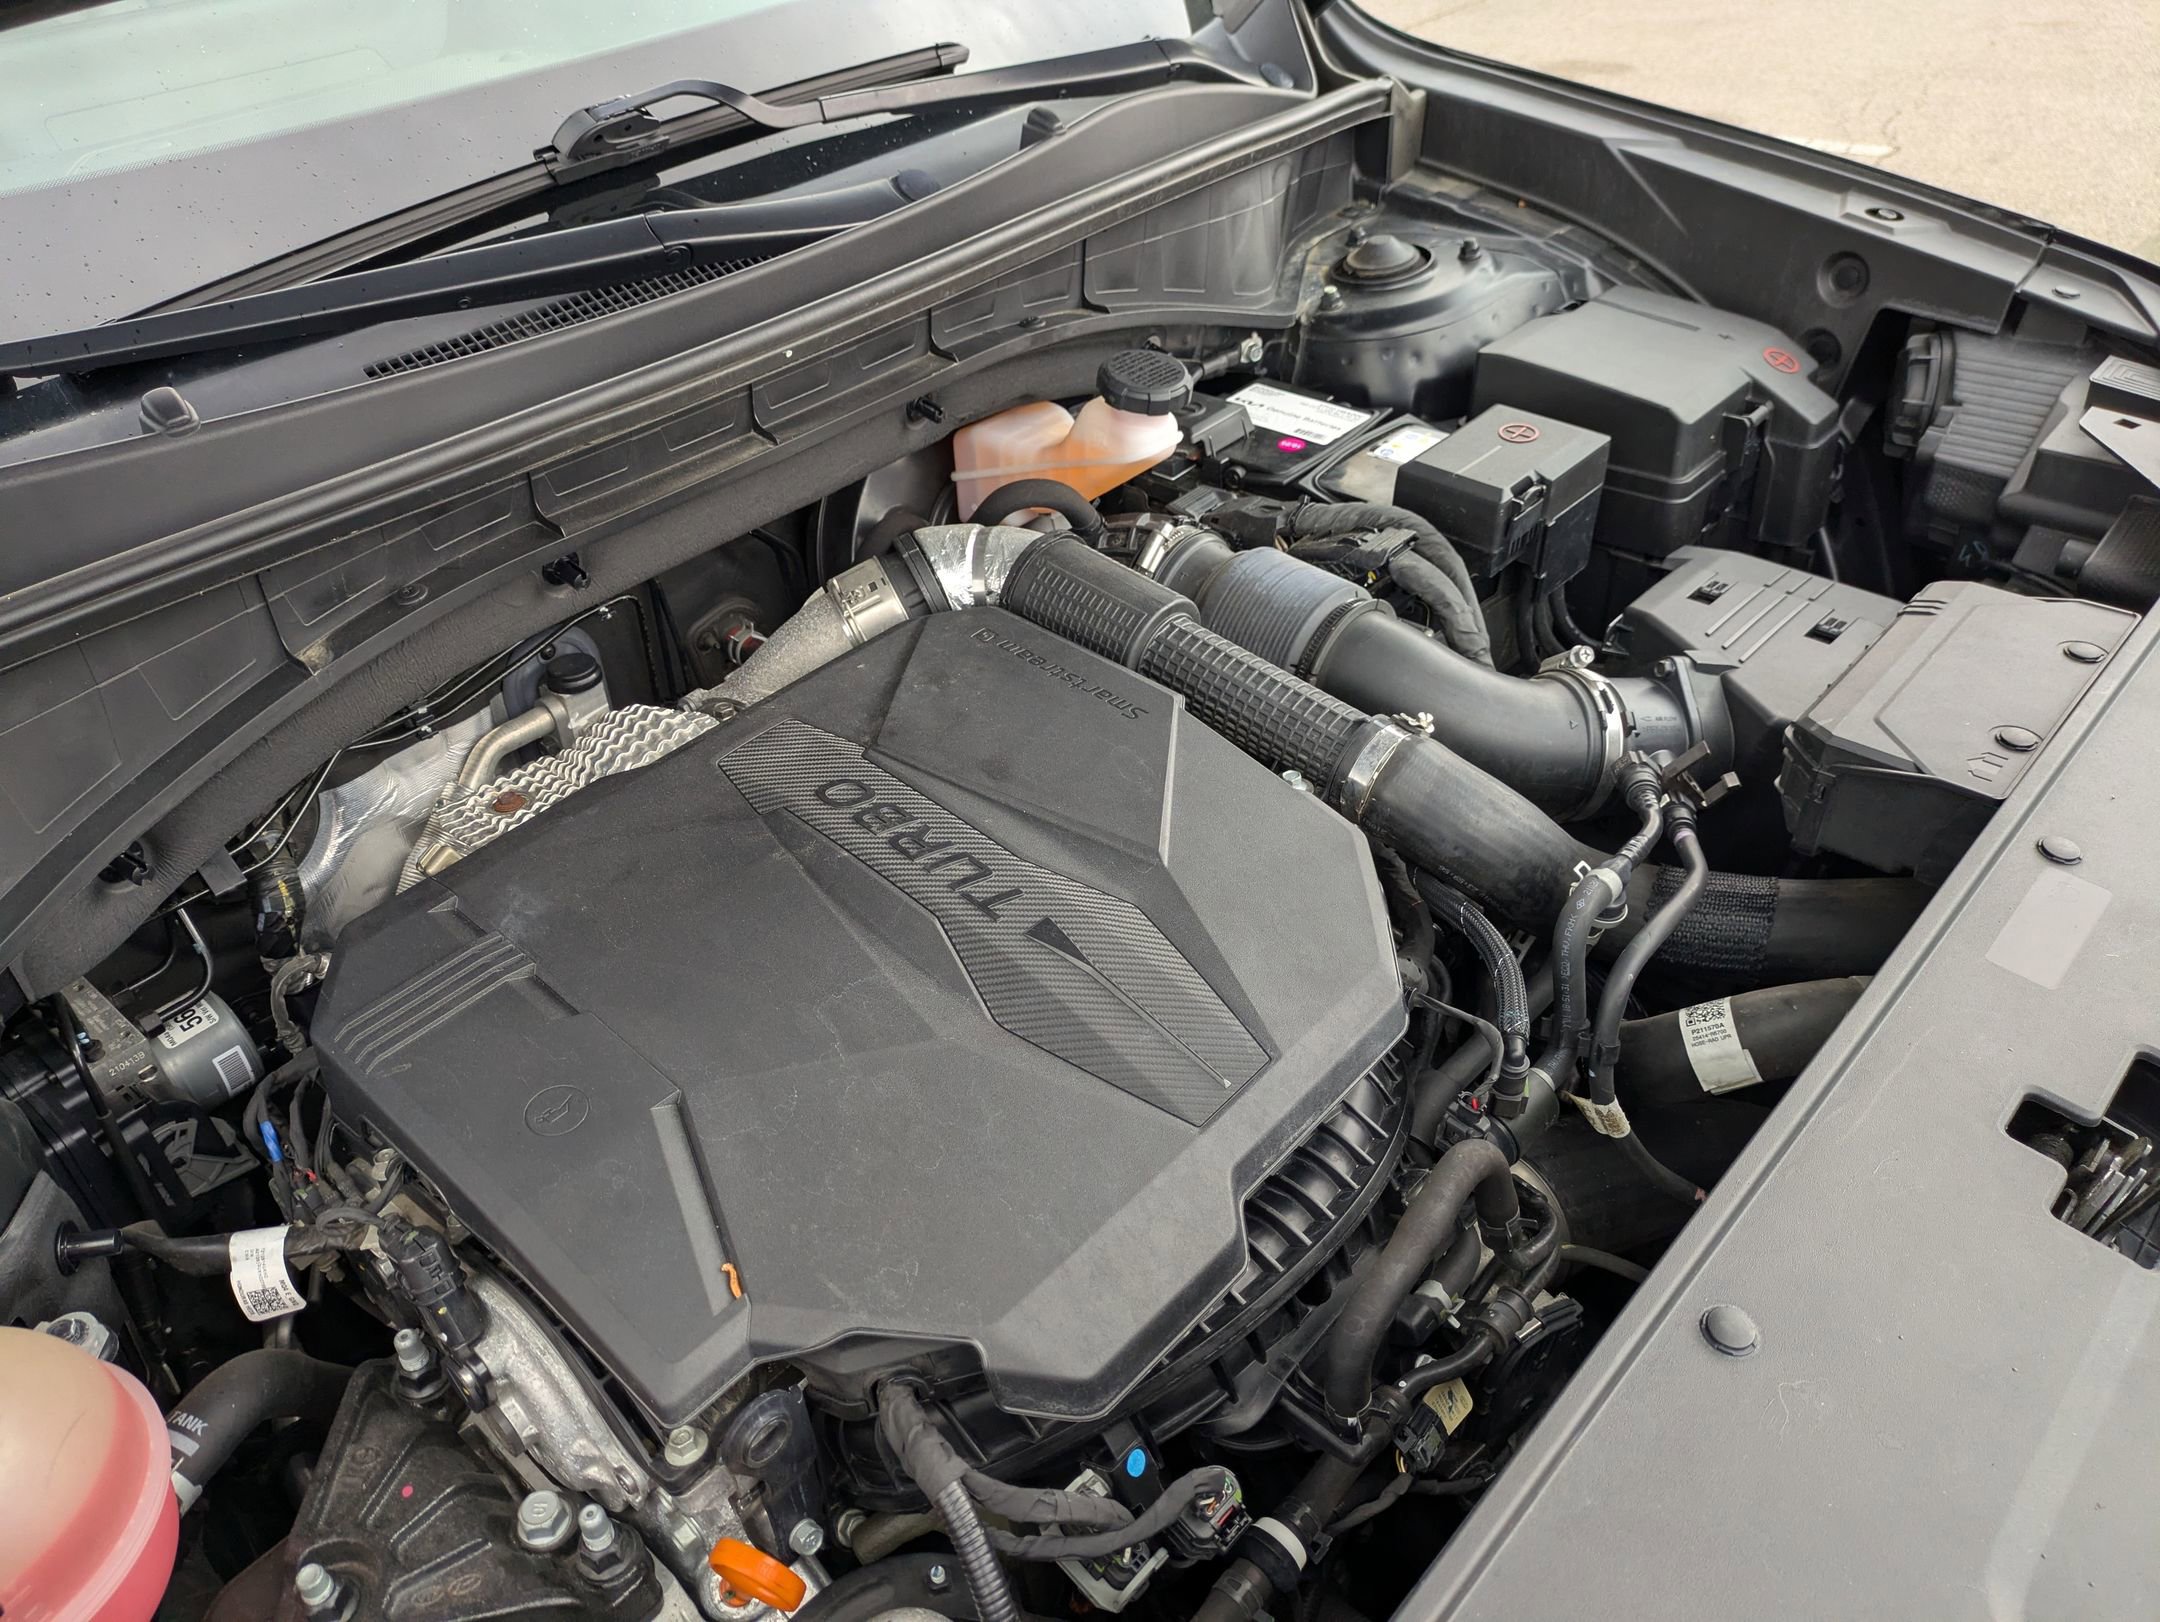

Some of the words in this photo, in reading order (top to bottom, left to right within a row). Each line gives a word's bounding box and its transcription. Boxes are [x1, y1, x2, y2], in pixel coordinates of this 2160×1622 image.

[995, 639, 1149, 719] Smartstream
[815, 778, 1024, 922] TURBO
[173, 1009, 203, 1032] 56
[167, 1410, 209, 1437] TANK
